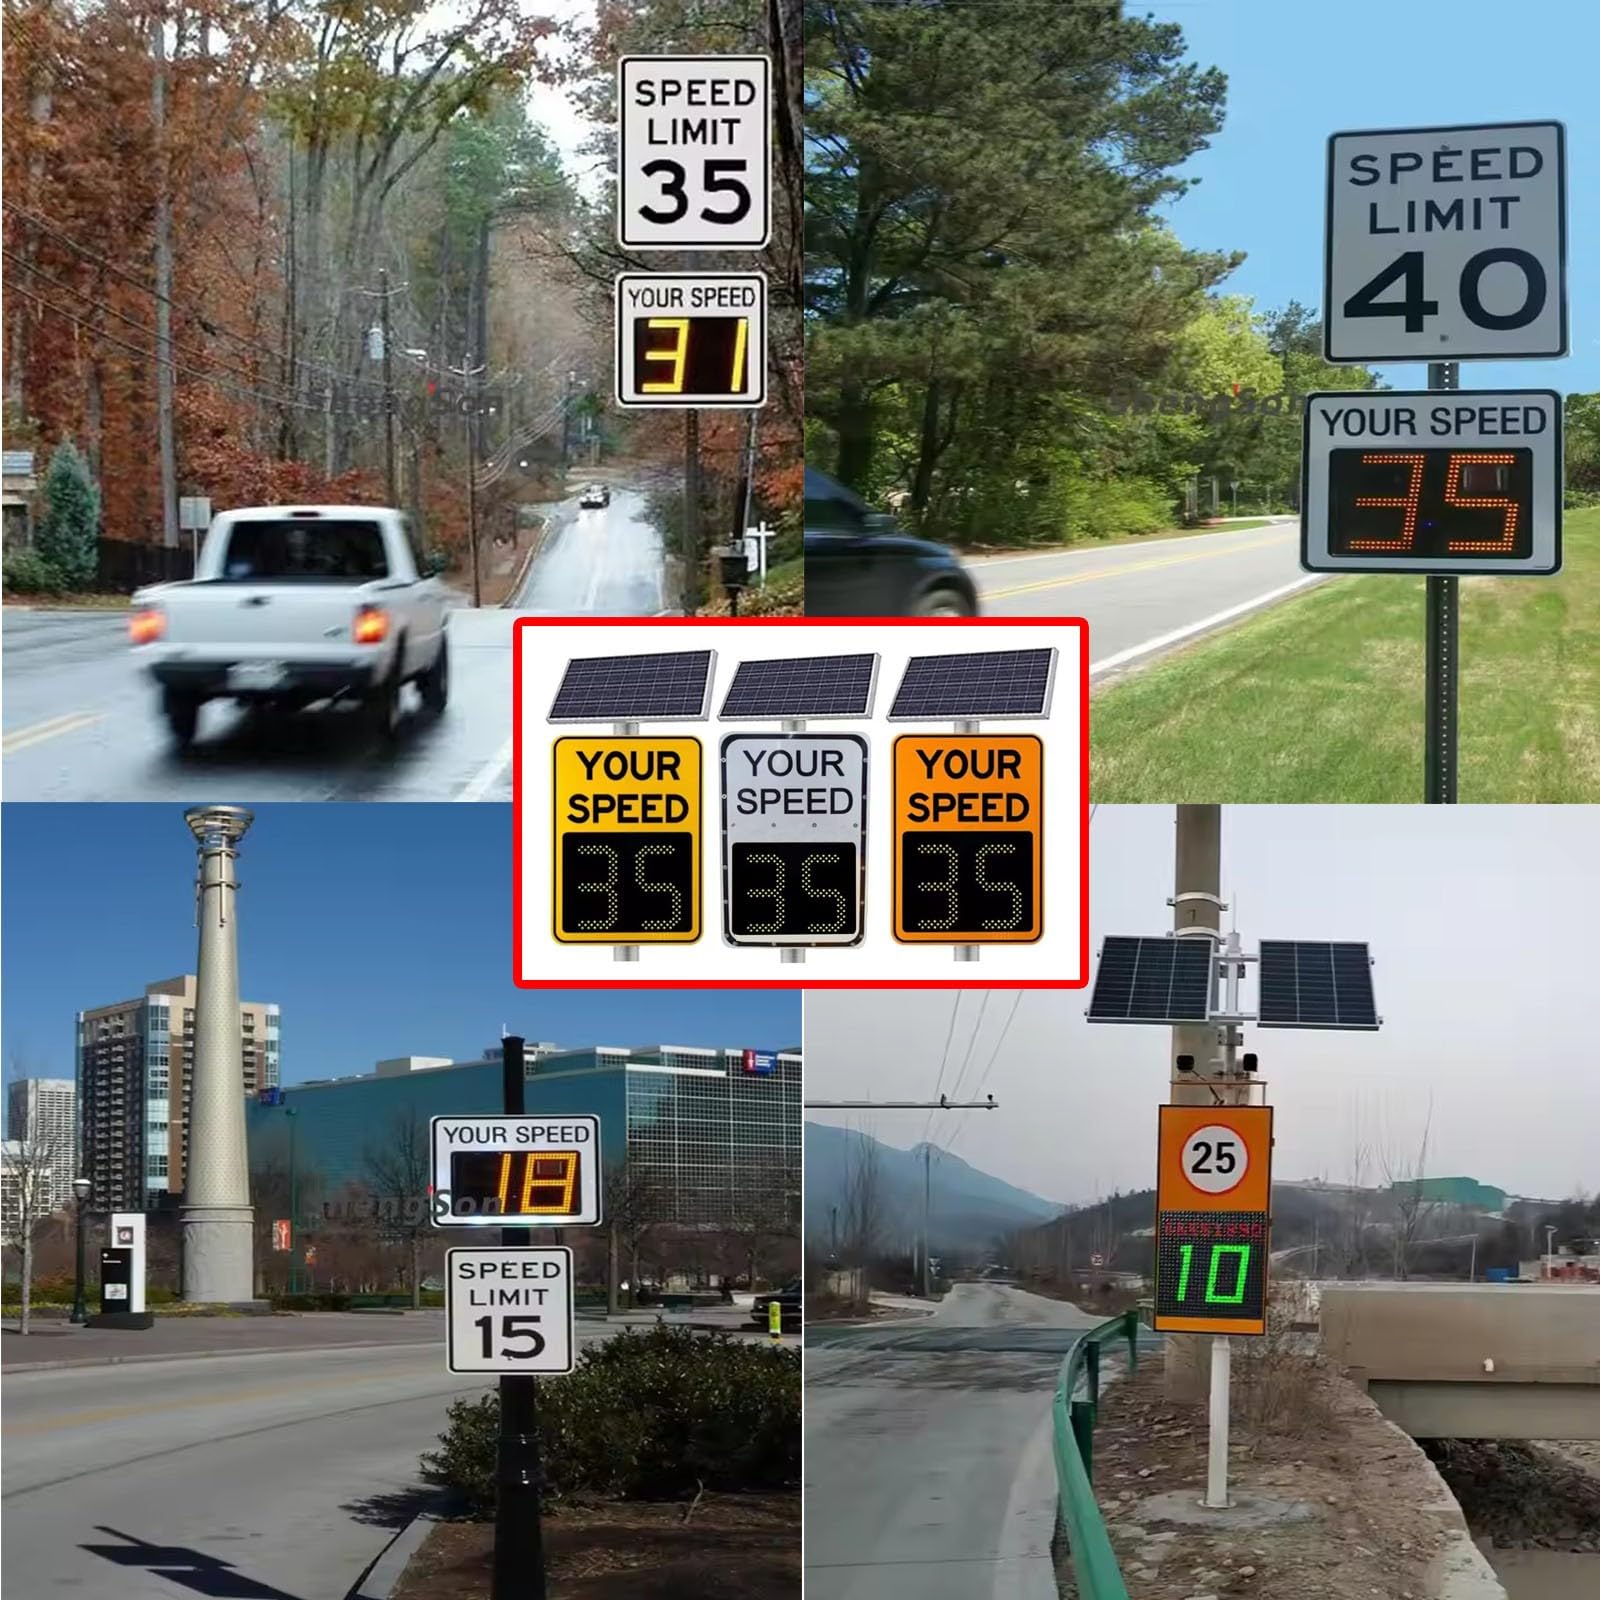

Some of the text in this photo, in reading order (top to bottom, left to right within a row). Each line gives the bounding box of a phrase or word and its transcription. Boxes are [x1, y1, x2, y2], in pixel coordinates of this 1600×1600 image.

[635, 79, 756, 107] SPEED
[648, 118, 741, 146] LIMIT
[1349, 146, 1544, 186] SPEED
[638, 159, 751, 225] 35
[1369, 196, 1521, 235] LIMIT
[628, 287, 756, 308] YOUR SPEED
[1343, 247, 1547, 334] 40
[641, 318, 748, 394] 31
[1320, 406, 1547, 437] YOUR SPEED
[1349, 454, 1519, 551] 35
[576, 751, 681, 781] YOUR
[743, 750, 844, 777] YOUR
[916, 749, 1022, 780] YOUR
[567, 793, 689, 824] SPEED
[736, 788, 854, 815] SPEED
[907, 792, 1030, 823] SPEED
[576, 844, 682, 931] 35
[746, 854, 846, 933] 35
[917, 843, 1023, 930] 35
[443, 1126, 590, 1144] YOUR SPEED
[1191, 1141, 1236, 1174] 25
[499, 1152, 577, 1214] 18
[459, 1262, 561, 1279] SPEED
[1176, 1244, 1250, 1303] 10
[470, 1289, 549, 1306] LIMIT
[474, 1315, 545, 1359] 15
